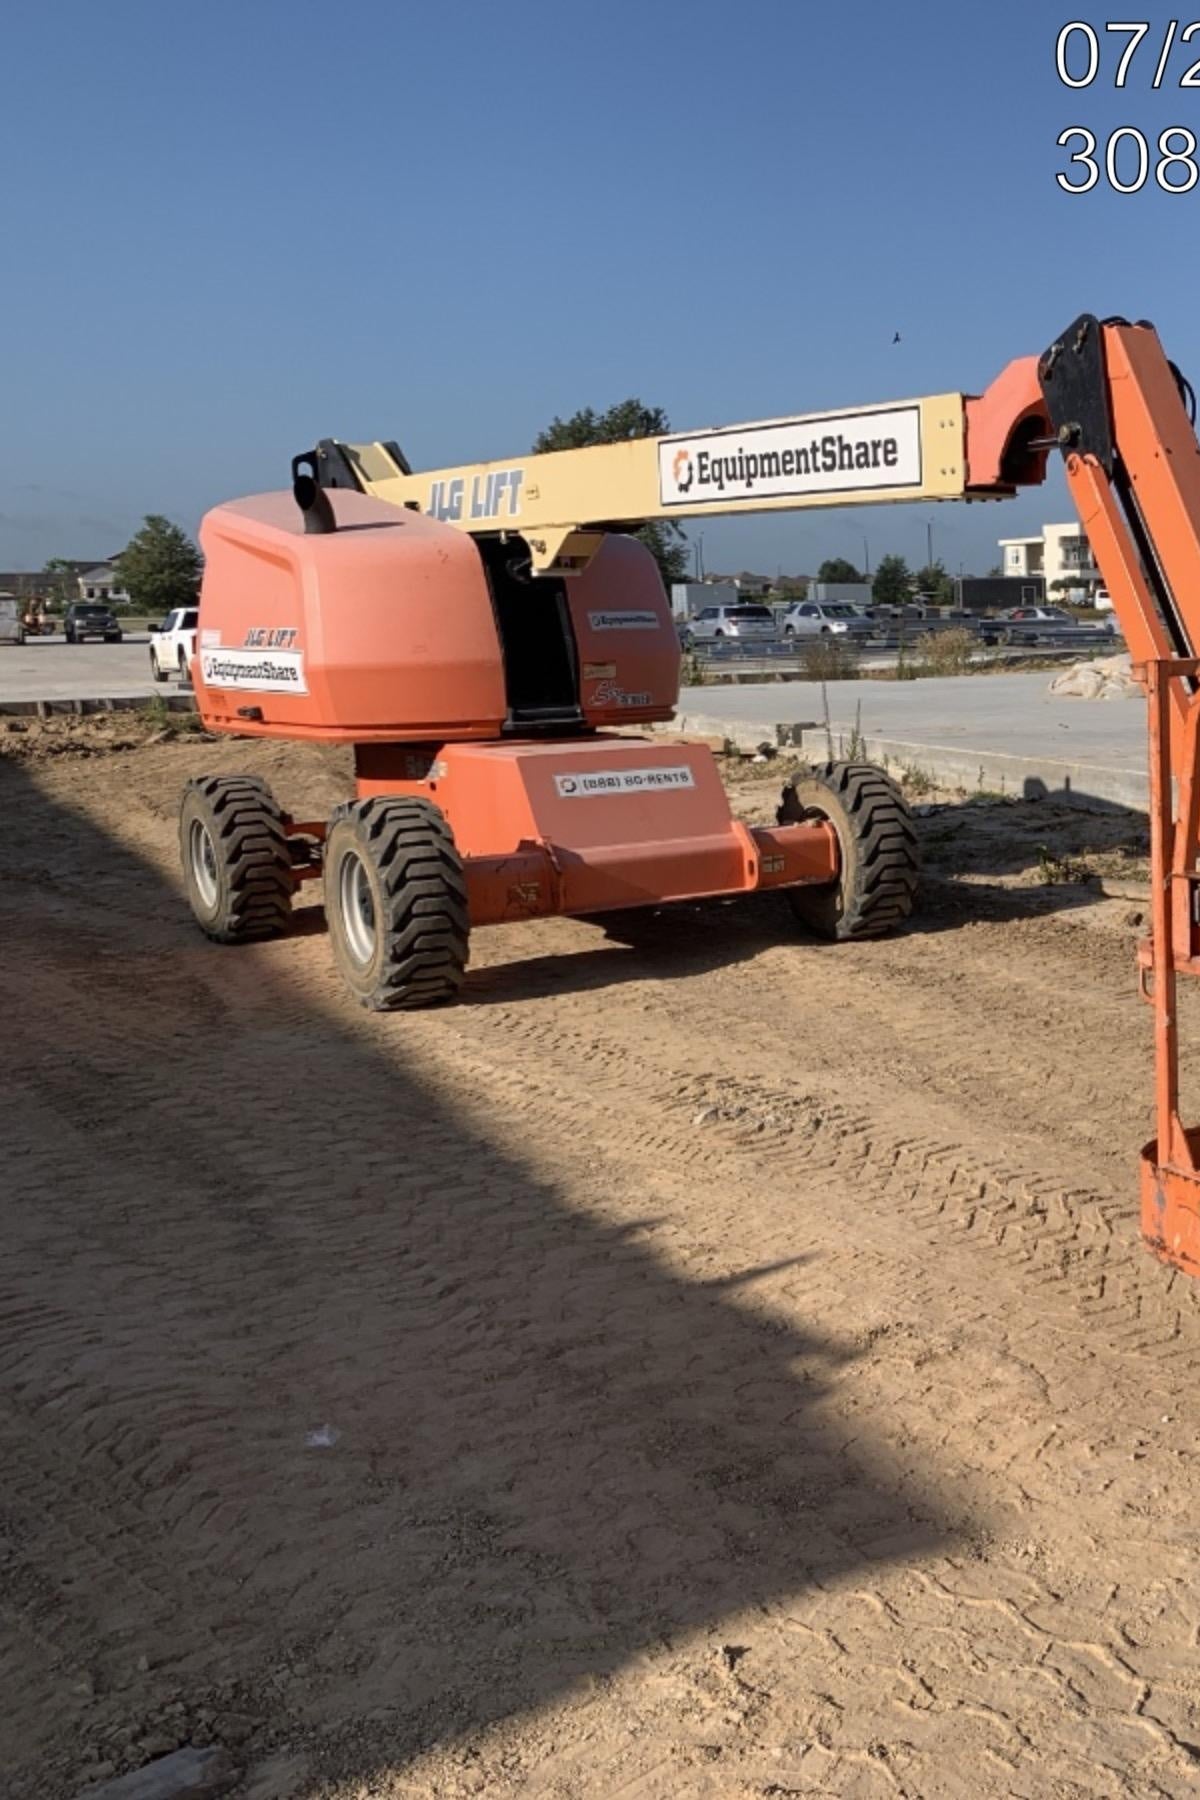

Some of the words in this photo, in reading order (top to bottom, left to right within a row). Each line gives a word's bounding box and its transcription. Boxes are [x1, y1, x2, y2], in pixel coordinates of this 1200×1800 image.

[697, 434, 899, 491] EquipmentShare
[425, 478, 465, 522] JLG
[469, 468, 524, 519] LIFT
